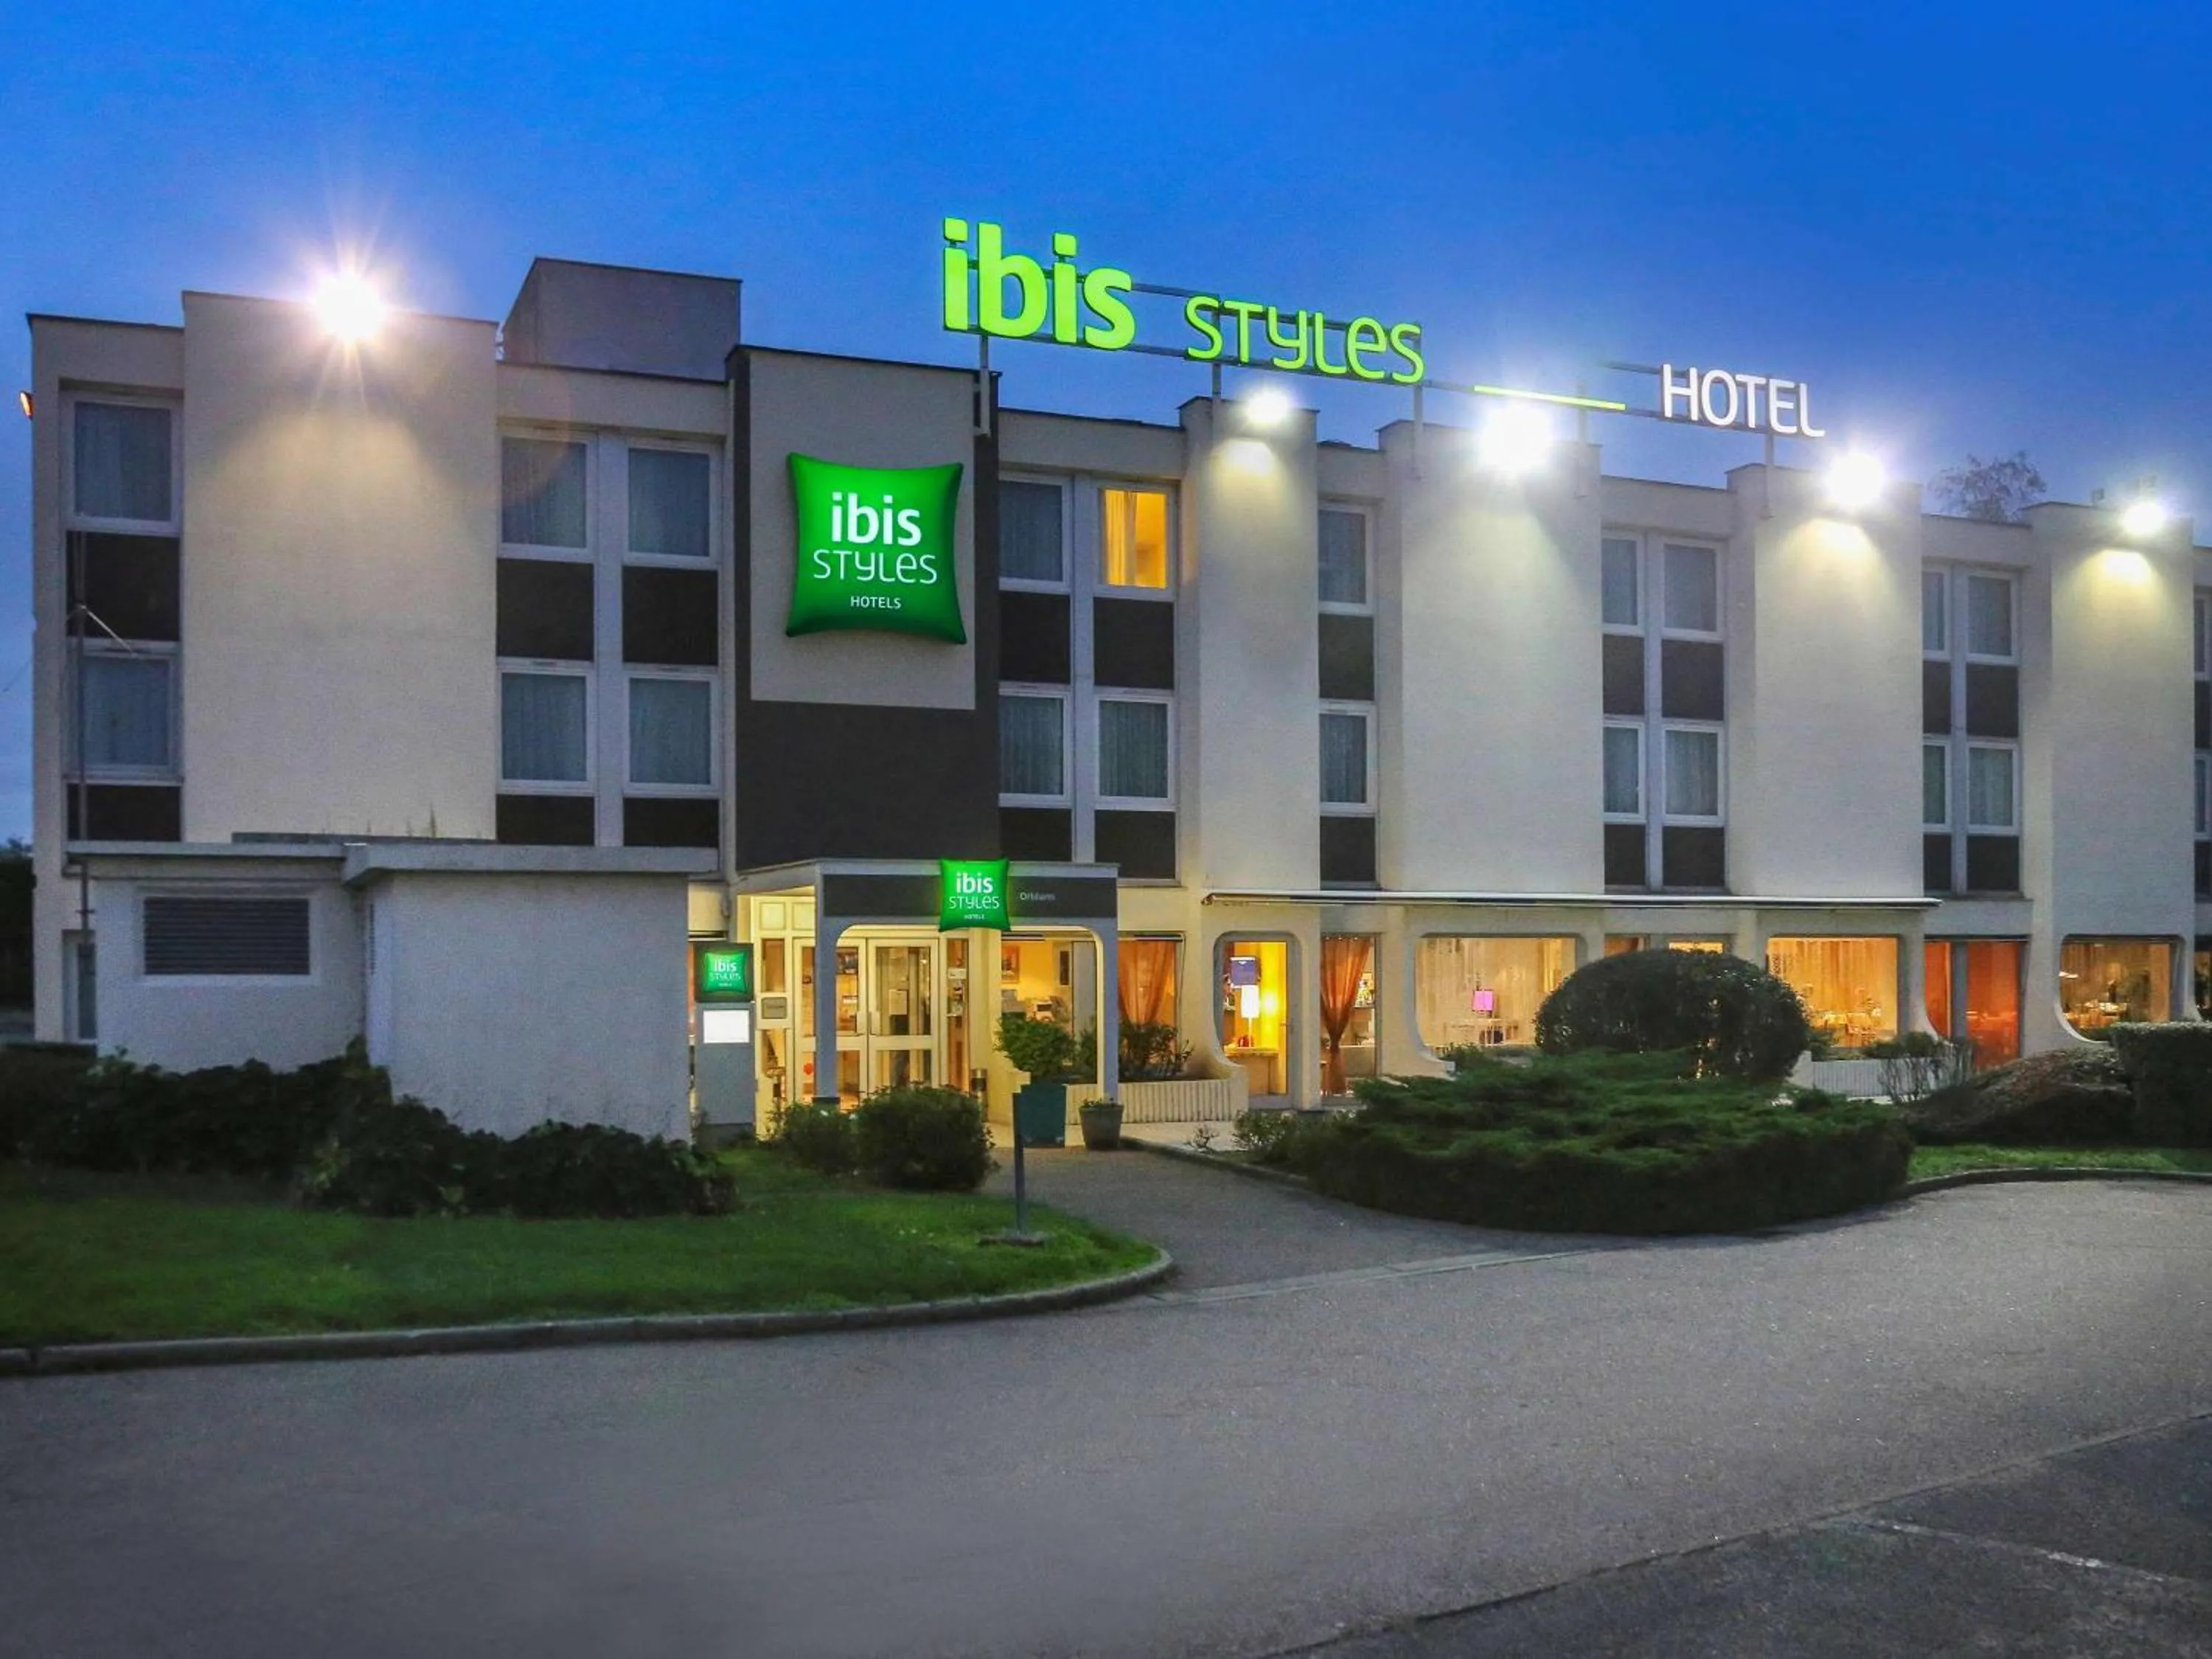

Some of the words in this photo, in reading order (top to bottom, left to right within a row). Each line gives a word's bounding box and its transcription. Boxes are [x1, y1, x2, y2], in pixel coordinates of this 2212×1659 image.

[944, 218, 1136, 349] ibis
[1186, 295, 1424, 383] STYLES
[1662, 363, 1826, 437] HOTEL
[832, 492, 921, 546] ibis
[813, 549, 937, 584] STYLES
[850, 596, 902, 610] HOTELS
[956, 872, 993, 894] ibis
[949, 895, 1000, 909] STYLES
